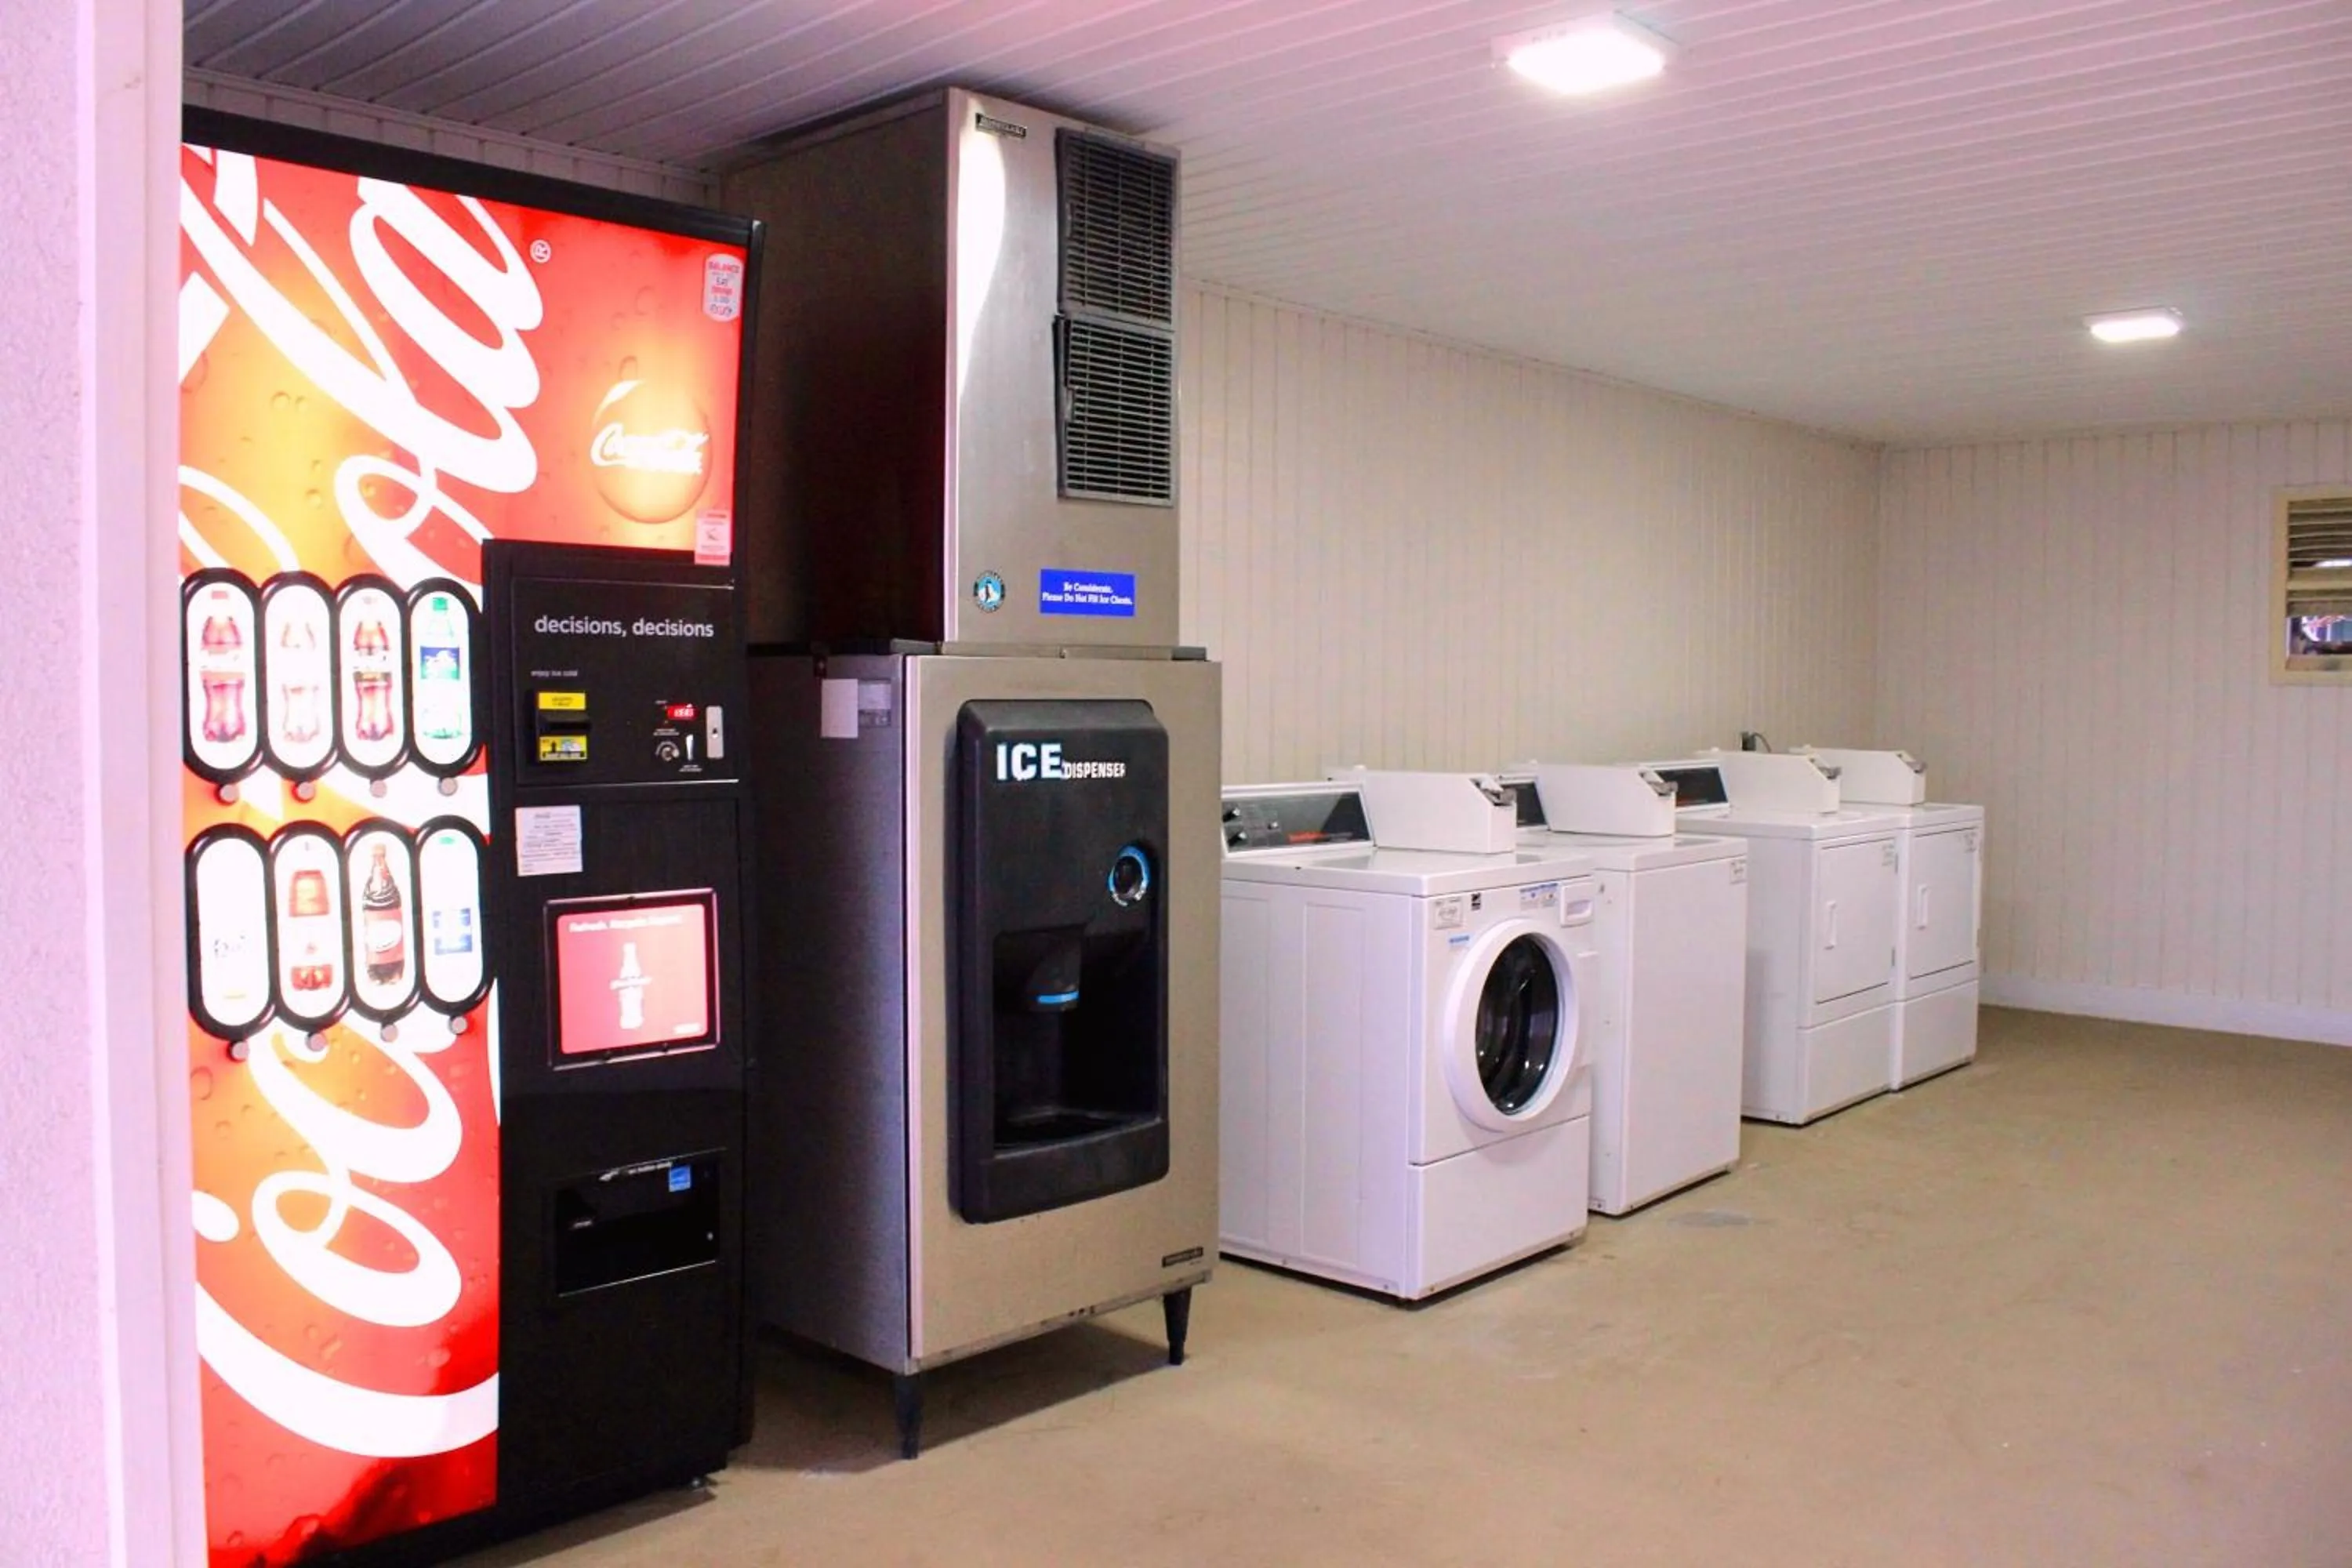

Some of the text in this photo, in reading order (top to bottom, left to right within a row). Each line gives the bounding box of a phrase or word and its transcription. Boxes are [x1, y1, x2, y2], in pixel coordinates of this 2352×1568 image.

[535, 615, 714, 637] decisions, decisions
[996, 742, 1126, 781] ICE DISPENSER
